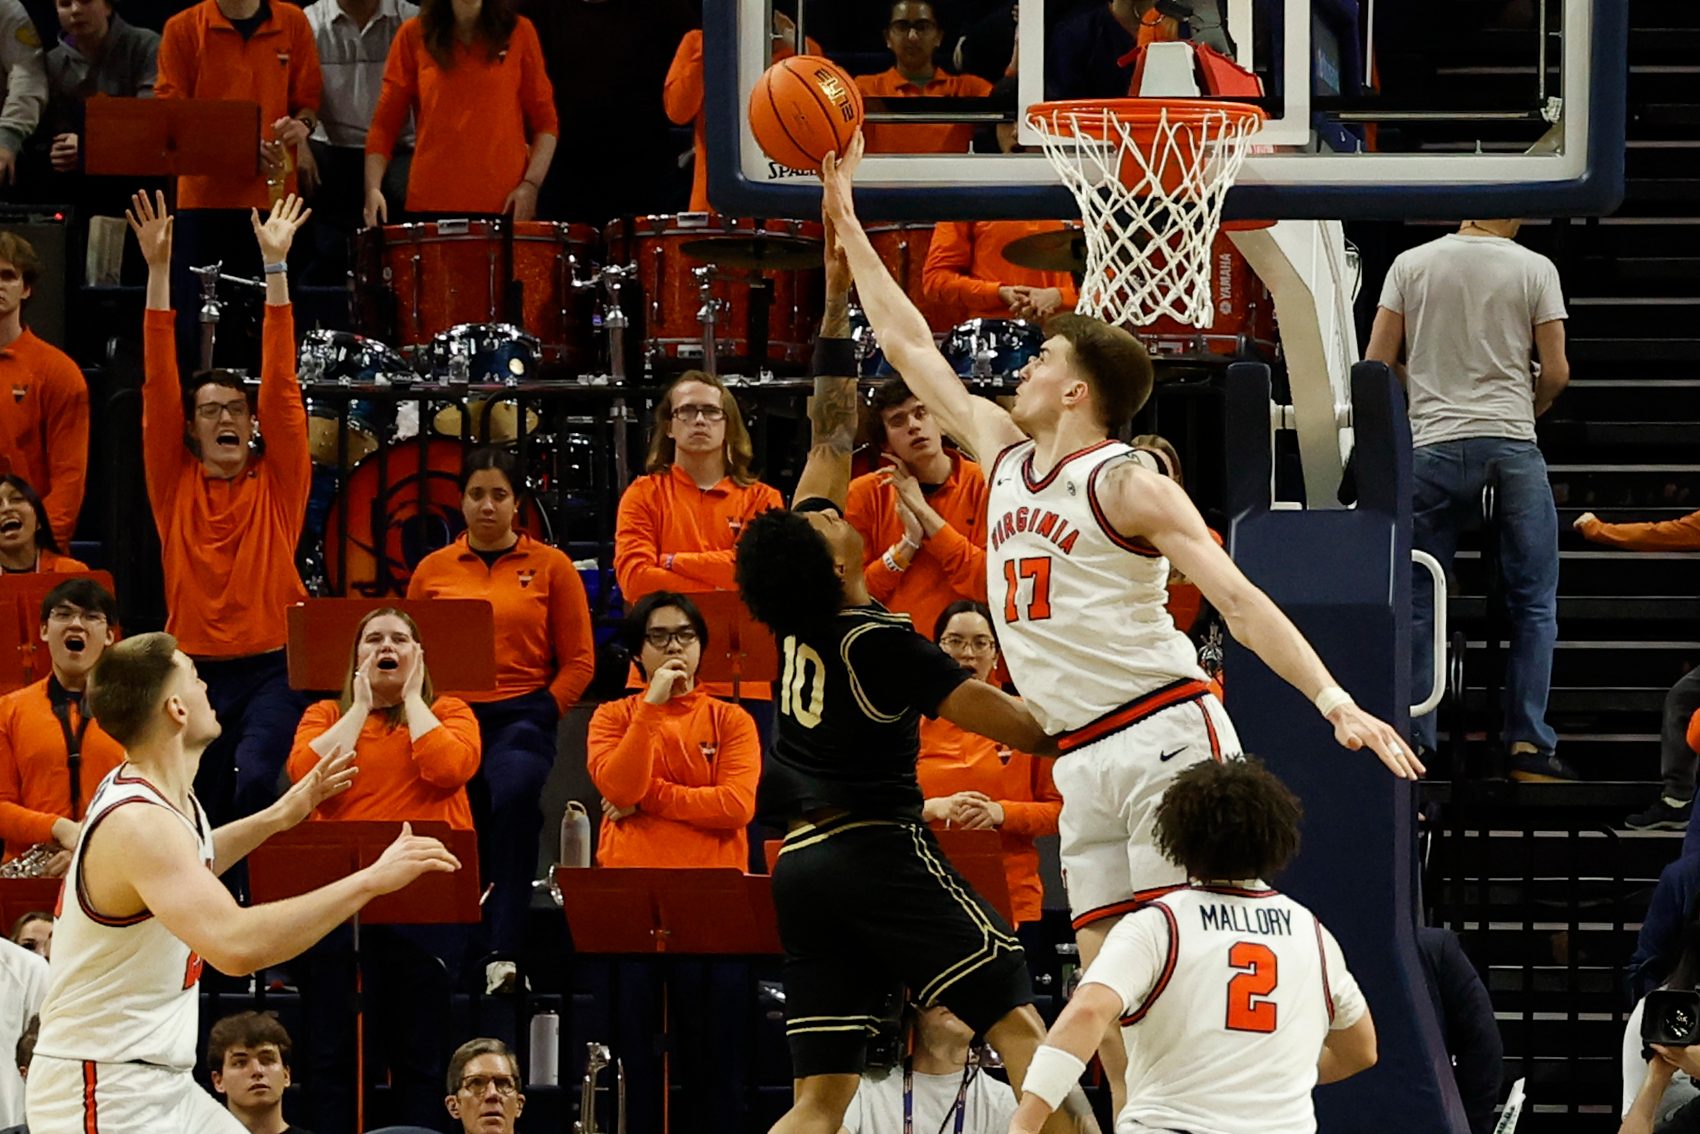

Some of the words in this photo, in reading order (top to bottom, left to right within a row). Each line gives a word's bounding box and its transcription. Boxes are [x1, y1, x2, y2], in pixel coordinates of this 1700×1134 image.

[1219, 253, 1231, 299] YAMAHA
[991, 507, 1080, 555] VIRGINIA
[1004, 556, 1052, 623] 17
[781, 634, 826, 729] 10
[1199, 904, 1292, 936] MALLORY
[1225, 941, 1278, 1033] 2
